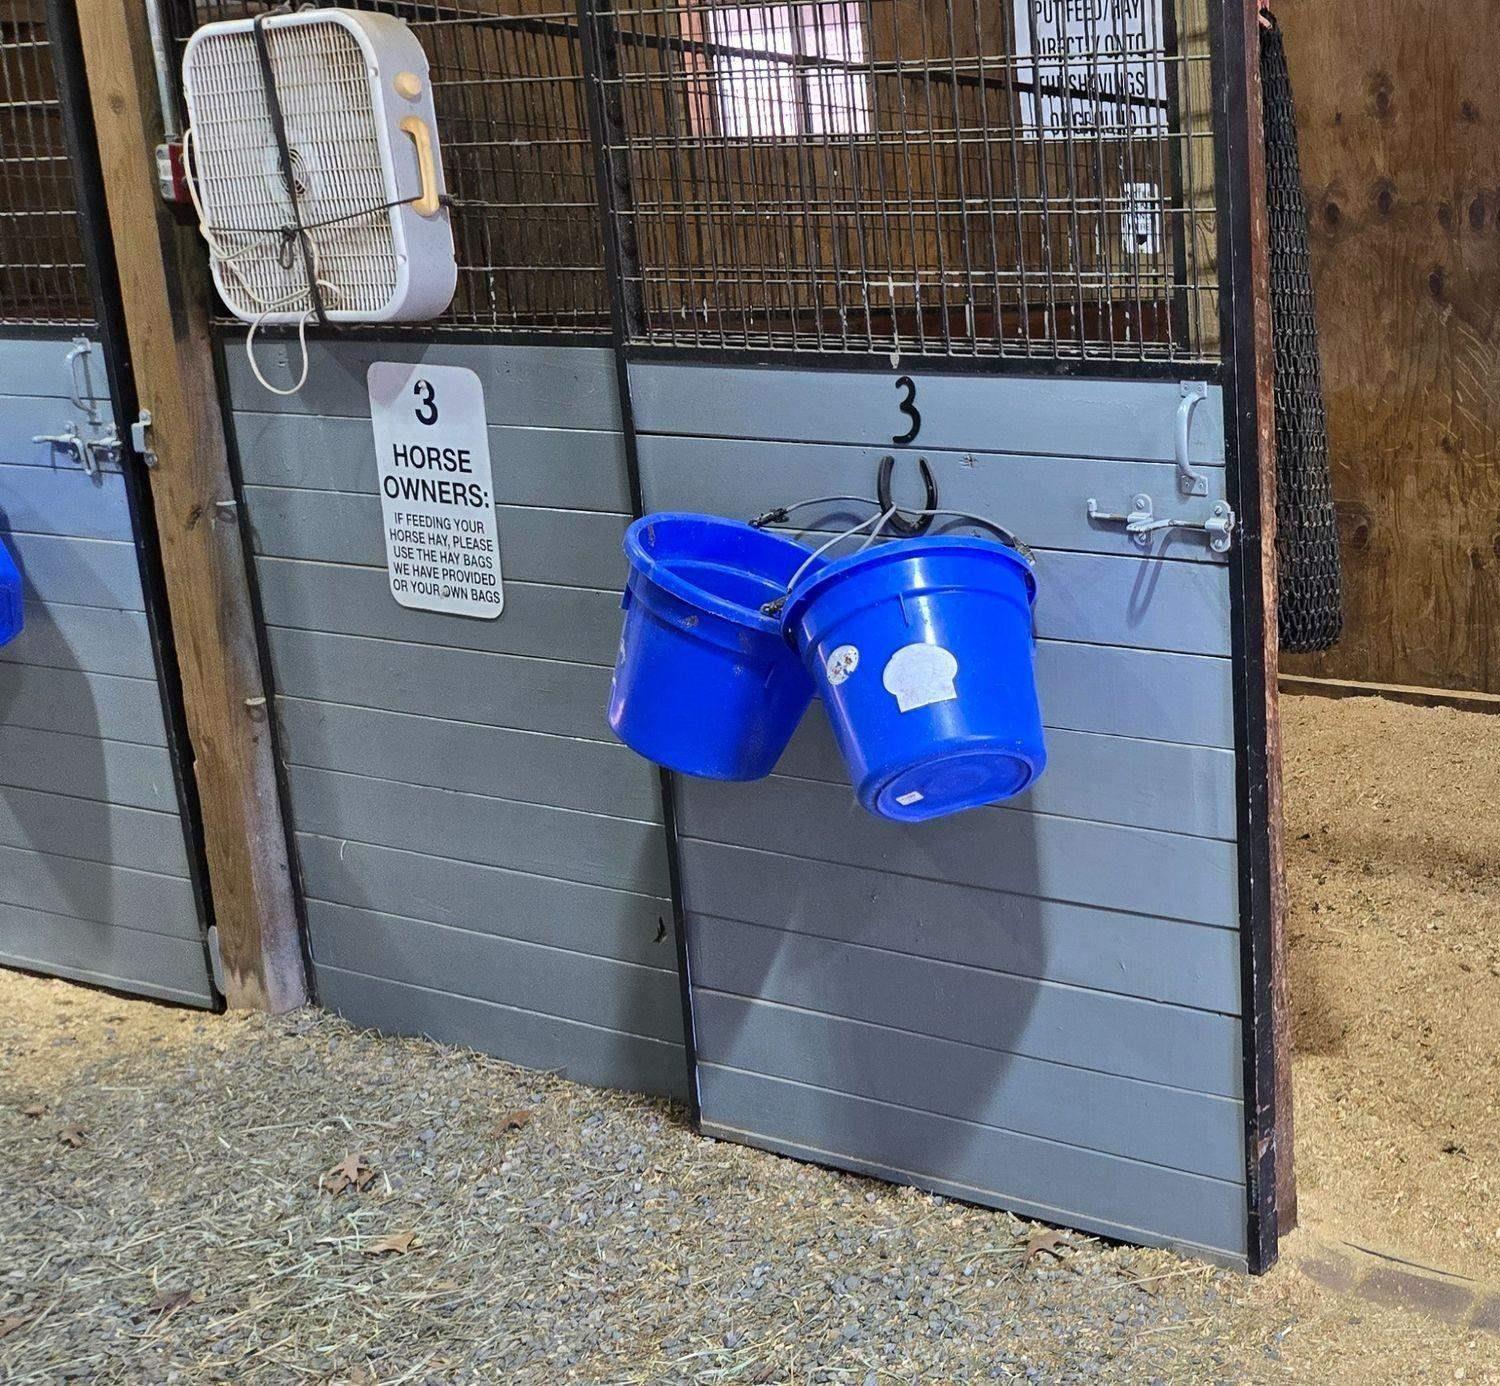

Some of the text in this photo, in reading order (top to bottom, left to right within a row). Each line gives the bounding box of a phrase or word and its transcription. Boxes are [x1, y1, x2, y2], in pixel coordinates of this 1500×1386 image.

[1034, 35, 1100, 61] DIRCTY
[1039, 71, 1145, 97] TH SHVINGS
[1071, 110, 1136, 135] GRUD
[413, 380, 439, 426] 3
[892, 376, 921, 444] 3
[393, 443, 473, 473] HORSE
[383, 475, 490, 508] OWNERS:
[394, 512, 485, 534] IF FEEDING YOUR
[389, 528, 493, 552] HORSE HAY, PLEASE
[393, 545, 493, 569] USE THE HAY BAGS
[393, 562, 496, 586] WE HAVE PROVIDED
[393, 578, 500, 604] OR YOUR OWN BAGS
